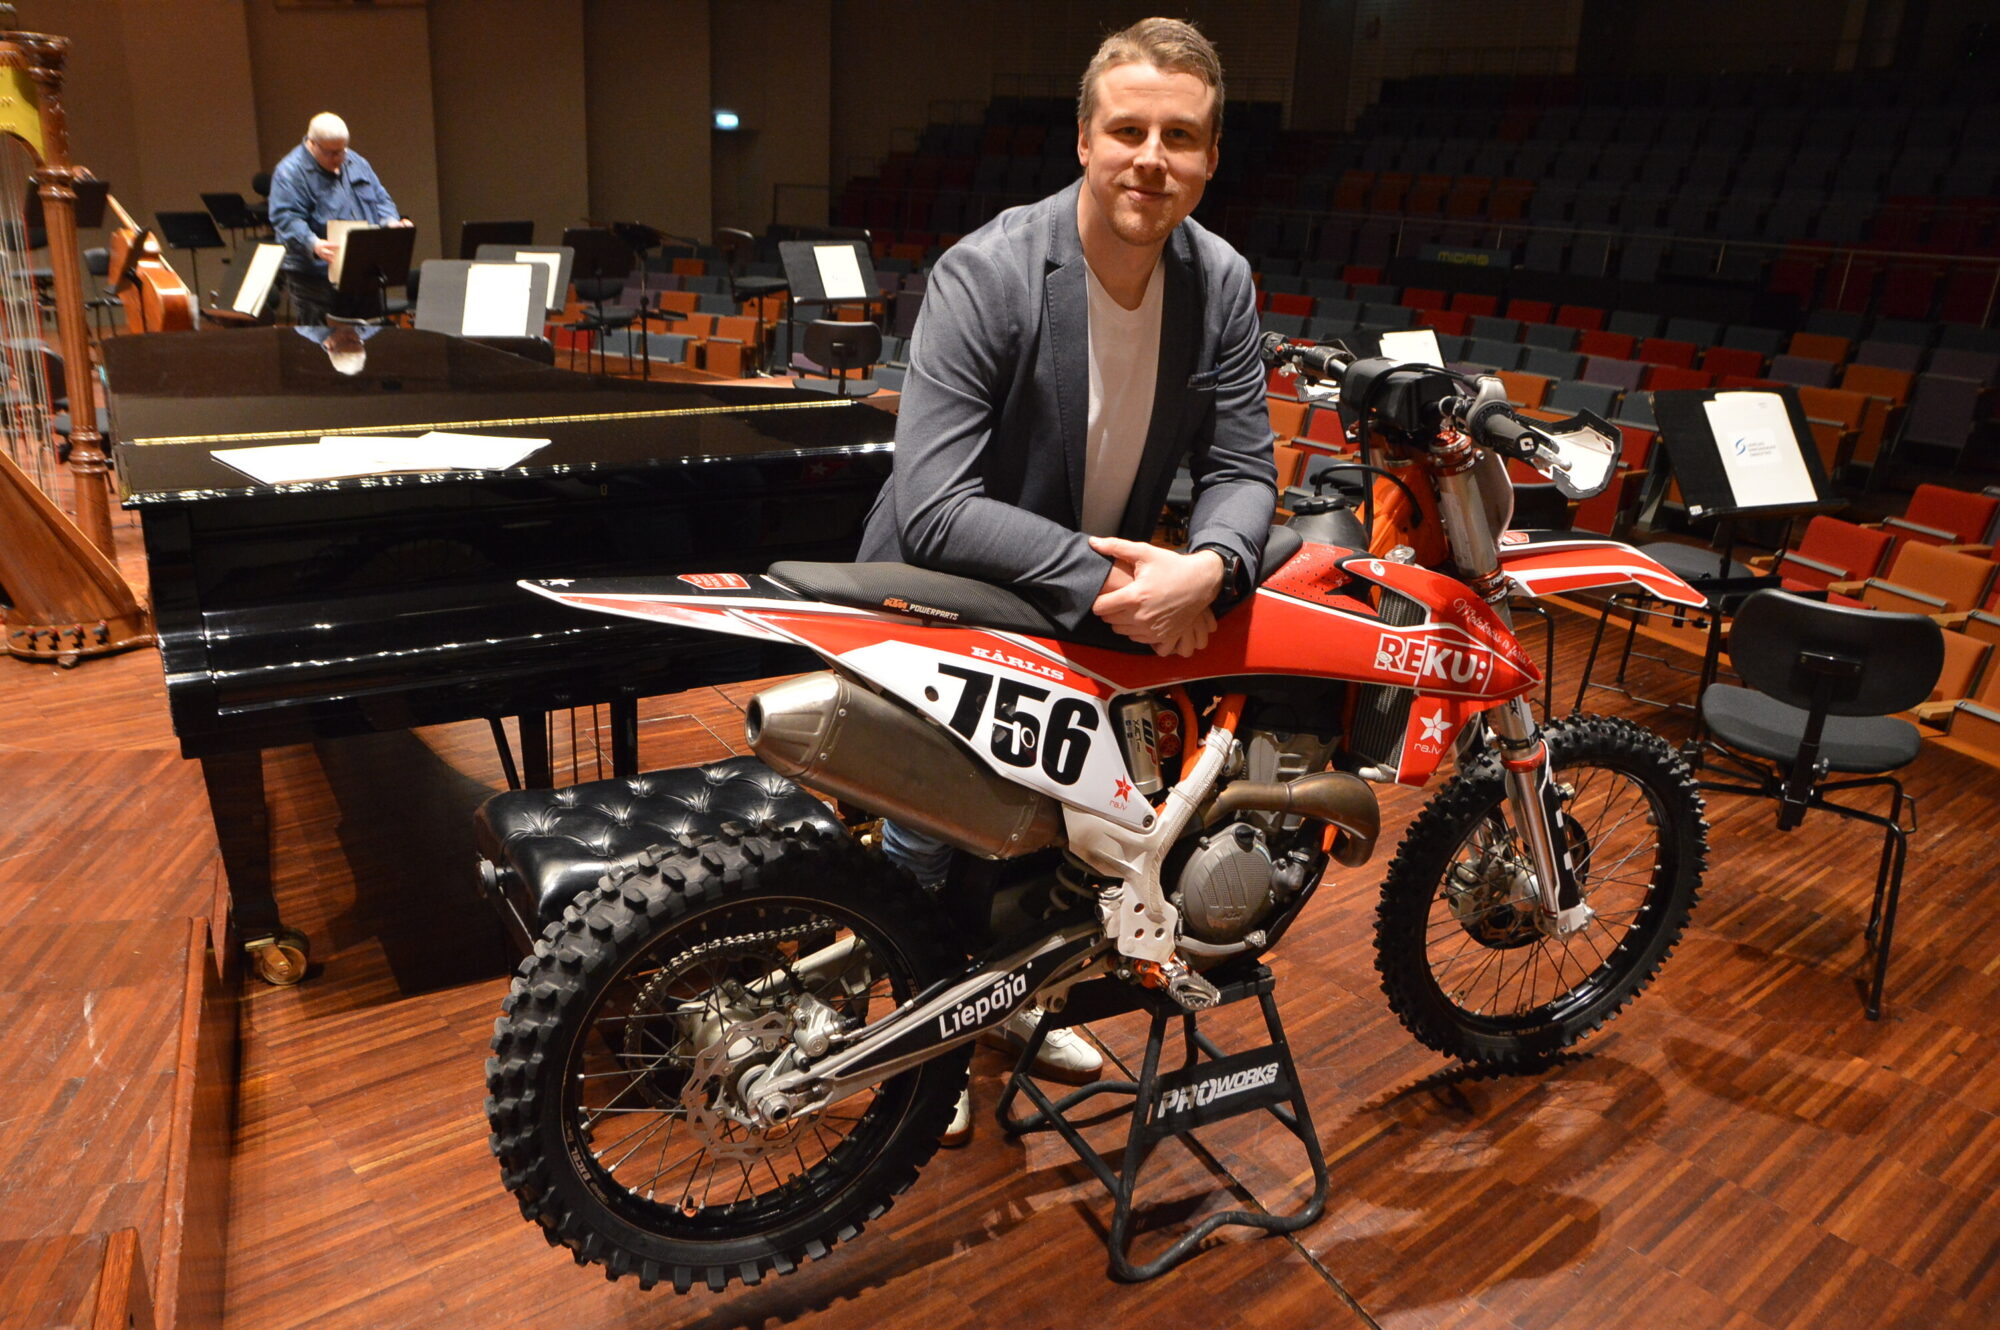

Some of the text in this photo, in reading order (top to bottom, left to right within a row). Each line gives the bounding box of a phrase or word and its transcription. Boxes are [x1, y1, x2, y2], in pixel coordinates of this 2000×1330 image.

[909, 603, 959, 621] POWERPARTS
[970, 646, 1065, 681] KĀRLIS
[938, 662, 1100, 786] 756
[1413, 743, 1442, 755] ra.lv
[938, 973, 1027, 1039] Liepāja
